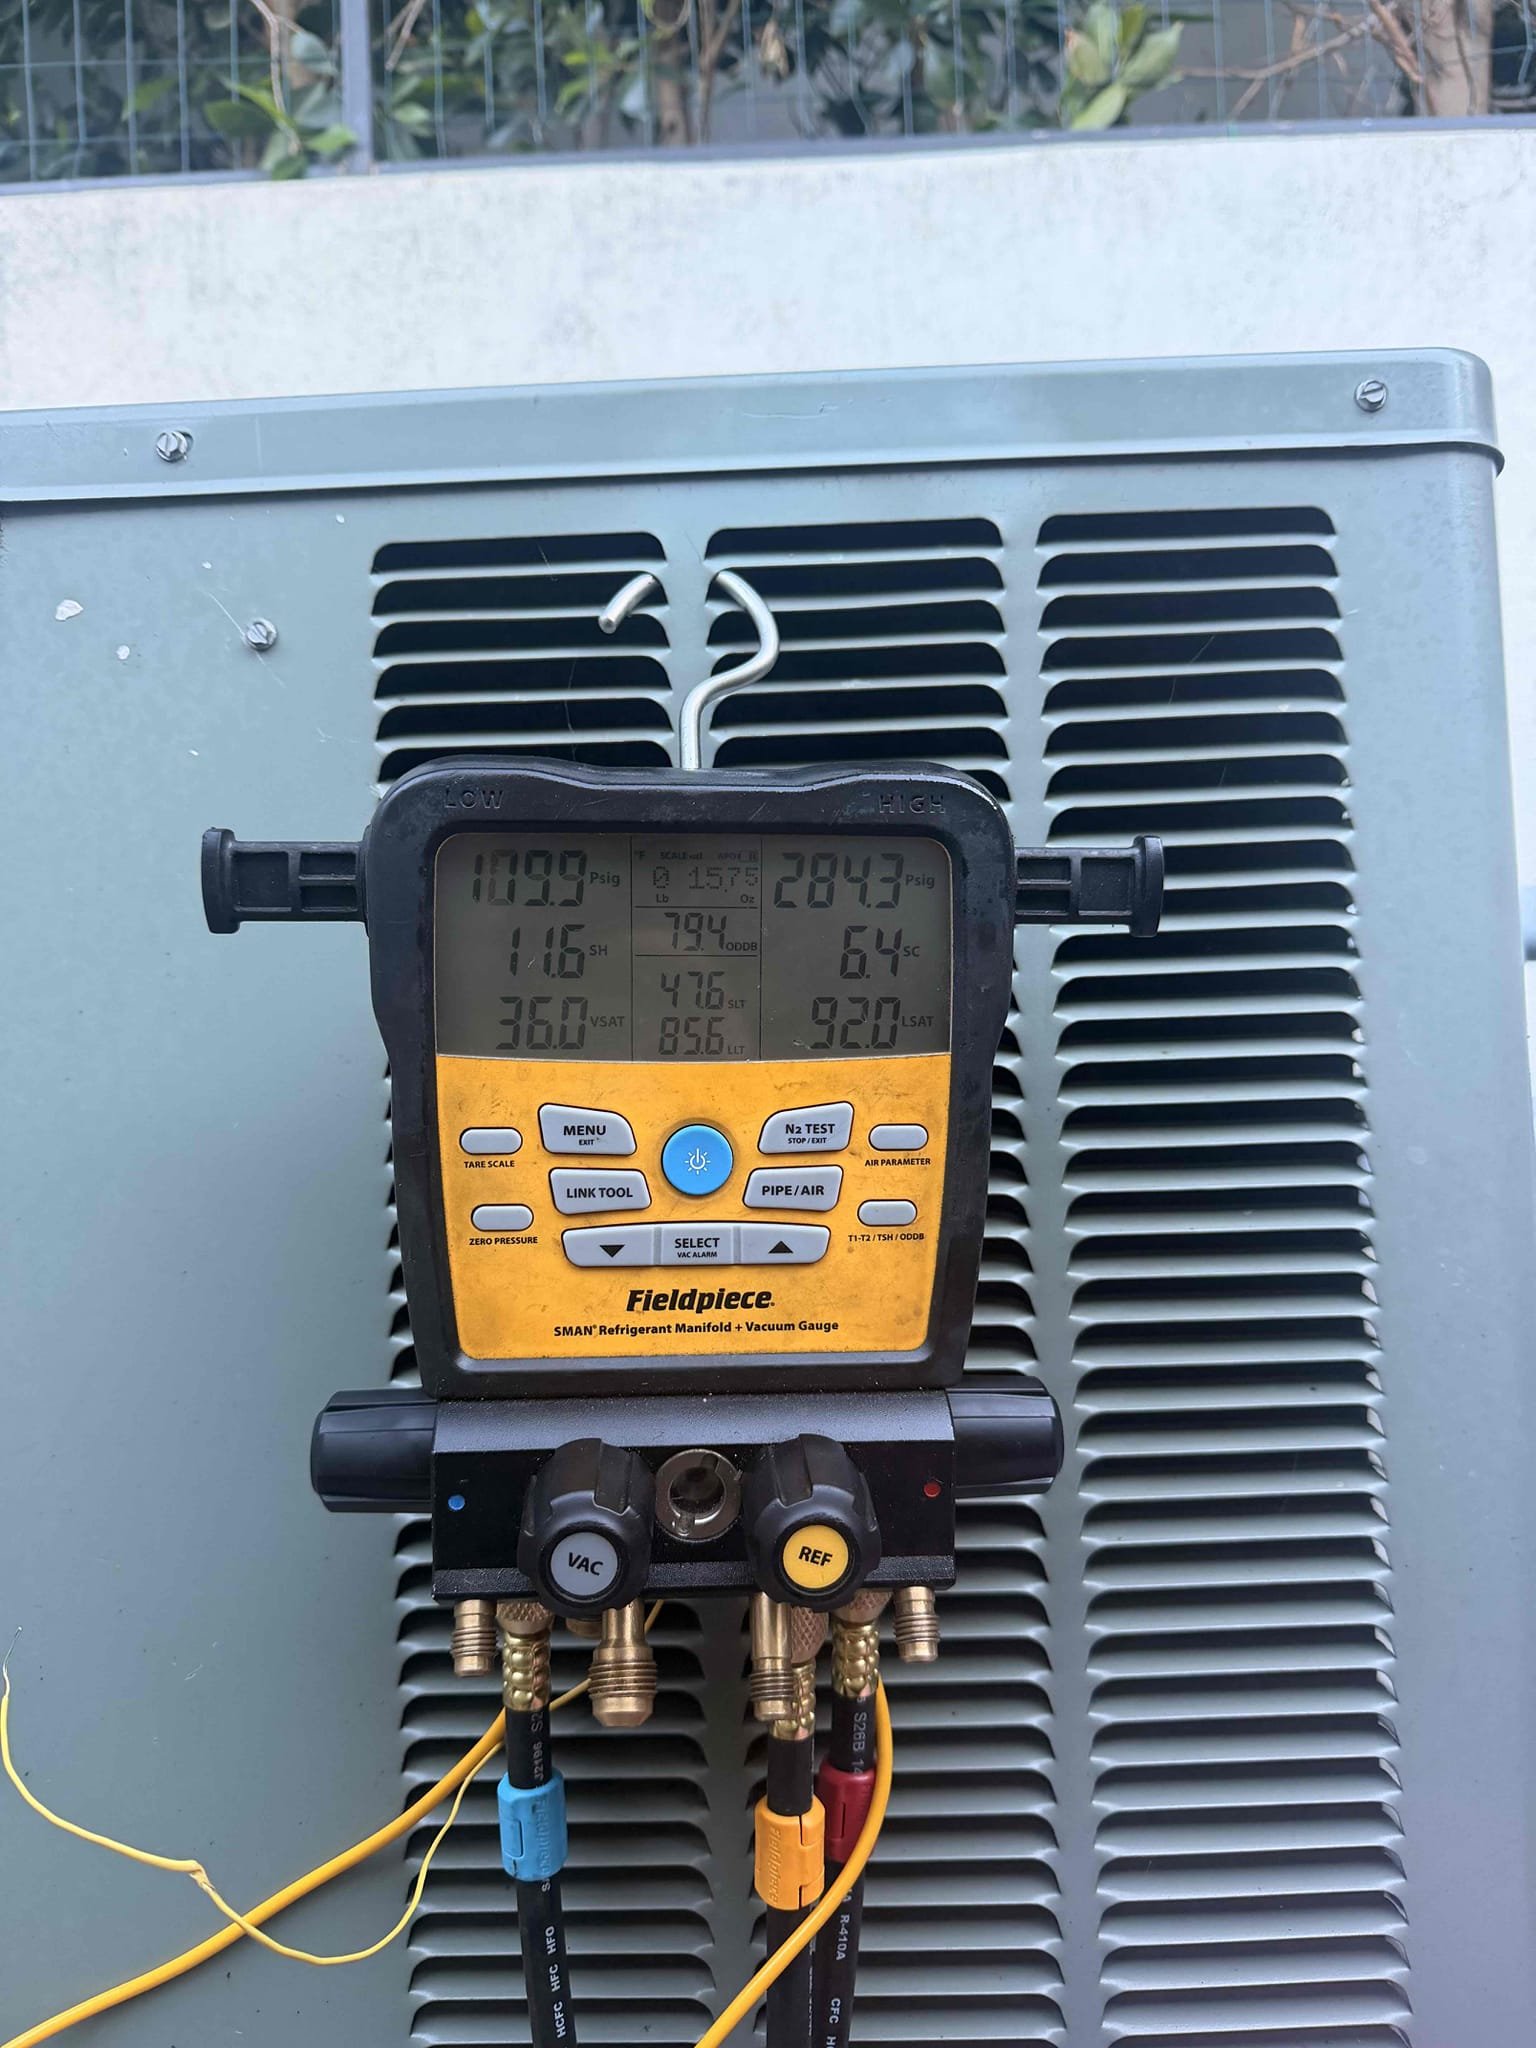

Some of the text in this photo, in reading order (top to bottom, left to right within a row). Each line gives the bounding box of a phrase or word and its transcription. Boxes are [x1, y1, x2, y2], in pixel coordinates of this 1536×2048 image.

[444, 788, 504, 809] LOW
[879, 794, 946, 814] HIGH
[590, 872, 621, 887] Psig
[774, 853, 936, 909] 284.3 Psig
[656, 893, 755, 904] Lb Oz
[589, 944, 608, 957] SH
[726, 942, 758, 952] ODDB
[840, 925, 920, 979] 6.4 SC
[727, 999, 746, 1009] SLT
[496, 996, 625, 1050] 36.0 VSAT
[810, 996, 934, 1050] 92.0 LSAT
[658, 1016, 745, 1056] 85.6 LLT
[563, 1125, 607, 1136] MENU
[805, 1123, 835, 1134] TEST
[487, 1160, 515, 1168] SCALE
[864, 1157, 931, 1167] AIR PARAMETER
[566, 1187, 633, 1198] LINK TOOL
[469, 1236, 538, 1246] ZERO PRESSURE
[674, 1237, 720, 1249] SELECT
[848, 1234, 871, 1242] T1-T2
[899, 1233, 924, 1241] ODDB
[626, 1288, 773, 1314] Fieldpiece
[598, 1323, 672, 1336] Refrigerant
[675, 1321, 732, 1333] Manifold
[734, 1323, 743, 1332] +
[745, 1321, 794, 1332] Vacuum
[798, 1320, 839, 1334] Gauge
[567, 1552, 603, 1576] VAC
[798, 1546, 833, 1567] REF
[852, 1711, 867, 1752] S26B
[545, 1926, 557, 1955] HFO
[836, 1914, 850, 1961] R-410A
[549, 1963, 561, 1992] HFC
[553, 2001, 566, 2039] HCFC
[829, 1998, 841, 2024] CFC
